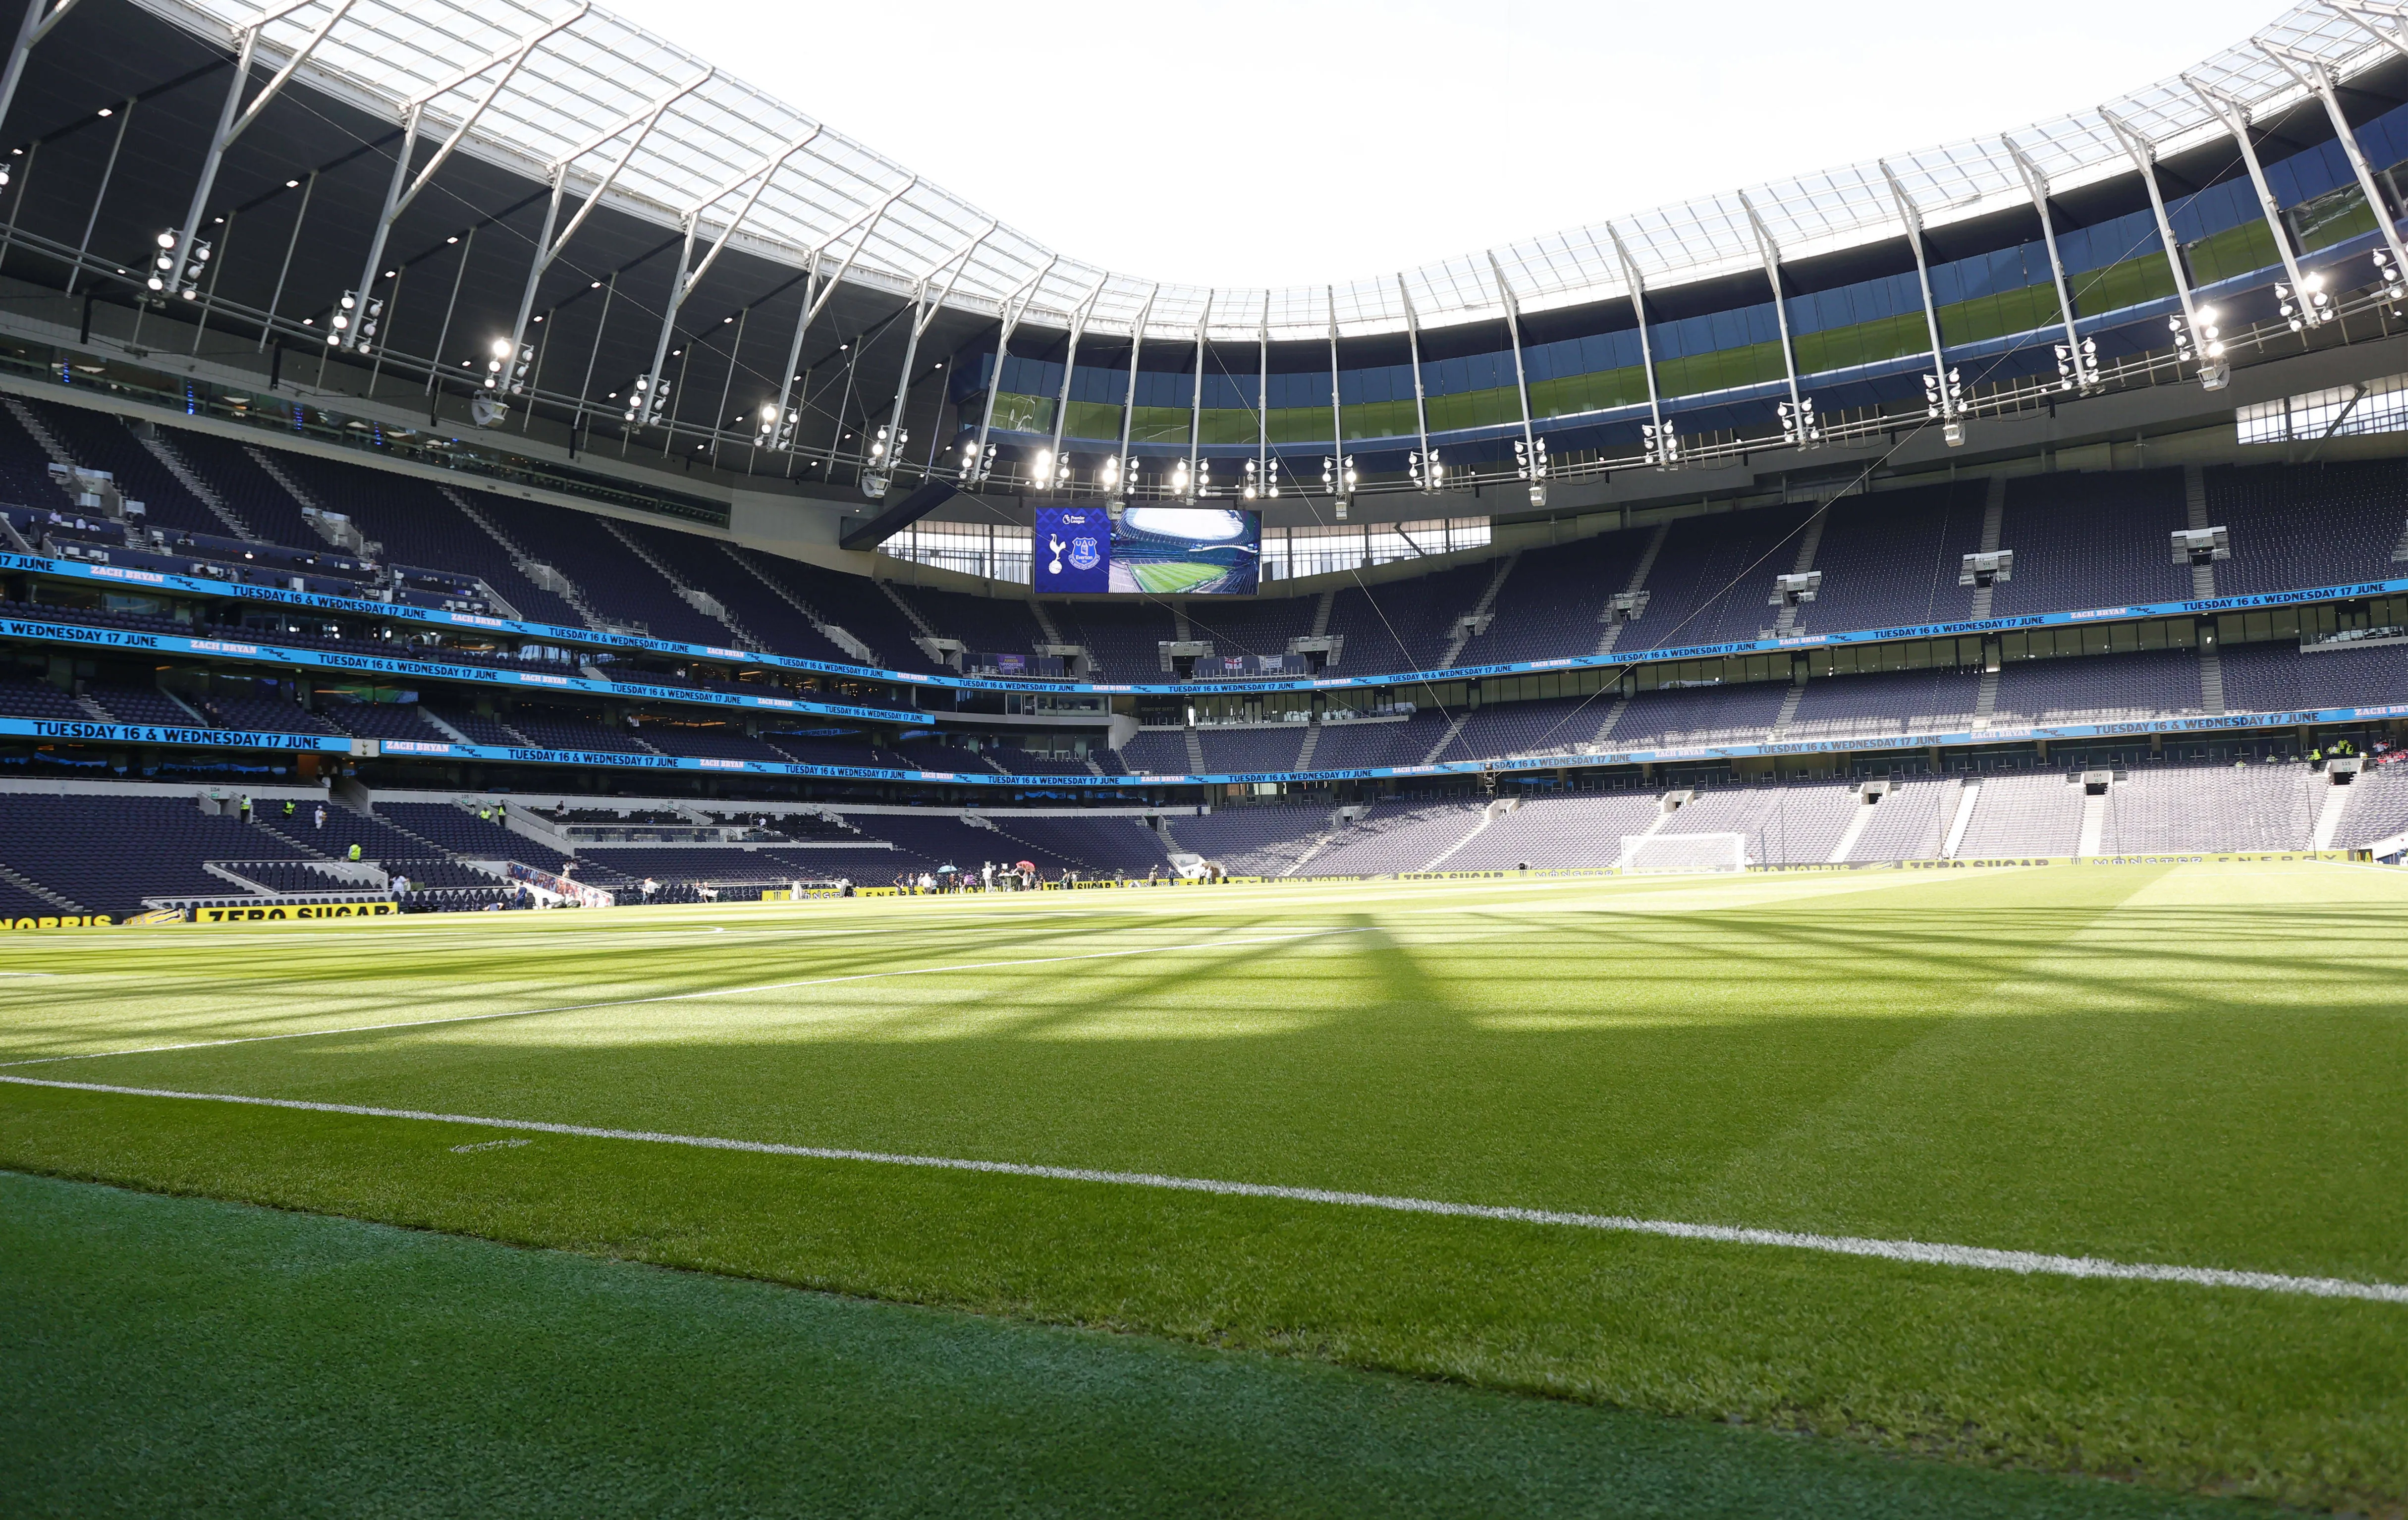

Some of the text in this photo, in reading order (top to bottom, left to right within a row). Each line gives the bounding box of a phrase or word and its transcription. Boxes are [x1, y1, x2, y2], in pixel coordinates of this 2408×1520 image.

[16, 557, 55, 572] JUNE
[91, 566, 163, 582] ZACH BRYAN
[231, 585, 427, 621] TUESDAY 16 & WEDNESDAY 17 JUNE
[2182, 583, 2386, 611] TUESDAY 16 & WEDNESDAY 17 JUNE
[451, 613, 501, 626] ZACH BRYAN
[2071, 610, 2095, 619] ZACH
[2096, 607, 2126, 616] BRYAN
[10, 623, 102, 644] WEDNESDAY
[107, 633, 120, 645] 17
[124, 635, 158, 650] JUNE
[1873, 628, 1916, 640] TUESDAY
[1919, 627, 1930, 636] 16
[1933, 626, 1939, 635] &
[1942, 620, 2003, 634] WEDNESDAY
[2020, 616, 2044, 627] JUNE
[191, 640, 256, 653] ZACH BRYAN
[548, 627, 588, 641] TUESDAY
[590, 633, 599, 643] 16
[610, 636, 658, 649] WEDNESDAY
[661, 643, 668, 652] 17
[670, 644, 689, 654] JUNE
[1611, 652, 1648, 662] TUESDAY
[1651, 651, 1659, 660] 16
[1670, 646, 1722, 658] WEDNESDAY
[1736, 643, 1757, 651] JUNE
[318, 654, 497, 682] TUESDAY 16 & WEDNESDAY 17 JUNE
[521, 674, 567, 684] ZACH BRYAN
[610, 684, 647, 696] TUESDAY
[649, 688, 657, 697] 16
[667, 689, 713, 703] WEDNESDAY
[715, 695, 722, 704] 17
[724, 696, 741, 706] JUNE
[2354, 706, 2387, 716] ZACH
[2093, 712, 2319, 734] TUESDAY 16 & WEDNESDAY 17 JUNE
[33, 721, 321, 750] TUESDAY 16 & WEDNESDAY 17 JUNE
[1970, 731, 1996, 740] ZACH
[1999, 729, 2032, 738] BRYAN
[386, 741, 414, 750] ZACH
[416, 743, 449, 753] BRYAN
[1757, 744, 1803, 754] TUESDAY
[1806, 743, 1817, 751] 16
[1831, 738, 1897, 750] WEDNESDAY
[1900, 737, 1911, 746] 17
[1915, 736, 1942, 745] JUNE
[508, 749, 678, 767] TUESDAY 16 & WEDNESDAY 17 JUNE
[785, 764, 819, 775] TUESDAY
[821, 767, 828, 776] 16
[837, 766, 880, 778] WEDNESDAY
[881, 770, 888, 778] 17
[889, 771, 906, 779] JUNE
[1288, 771, 1339, 781] WEDNESDAY
[1353, 770, 1372, 779] JUNE
[209, 905, 391, 922] ZERO SUGAR
